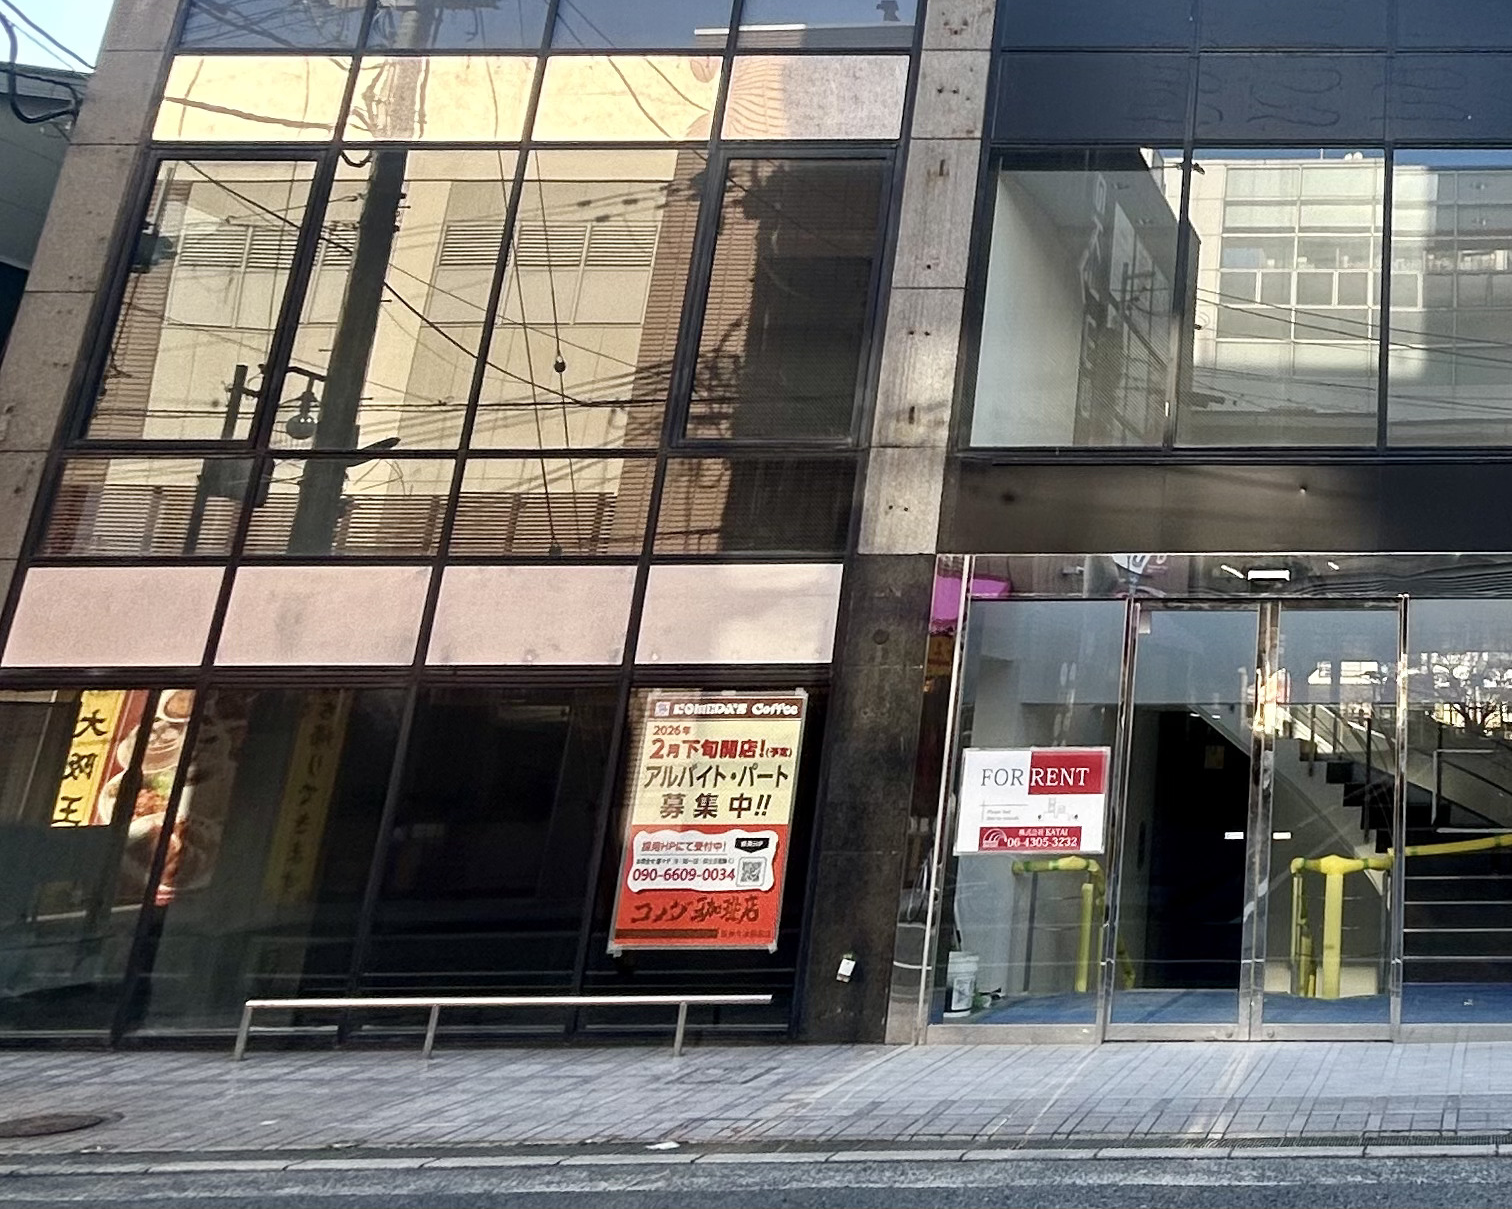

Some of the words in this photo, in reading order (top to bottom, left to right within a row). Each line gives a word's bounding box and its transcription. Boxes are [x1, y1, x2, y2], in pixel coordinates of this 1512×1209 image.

[751, 702, 799, 716] Coffee
[653, 724, 692, 736] 2026年
[644, 762, 788, 789] アルバイト・パート
[981, 768, 1025, 787] FOR
[1030, 766, 1090, 787] RENT
[632, 867, 736, 882] 090-6609-0034
